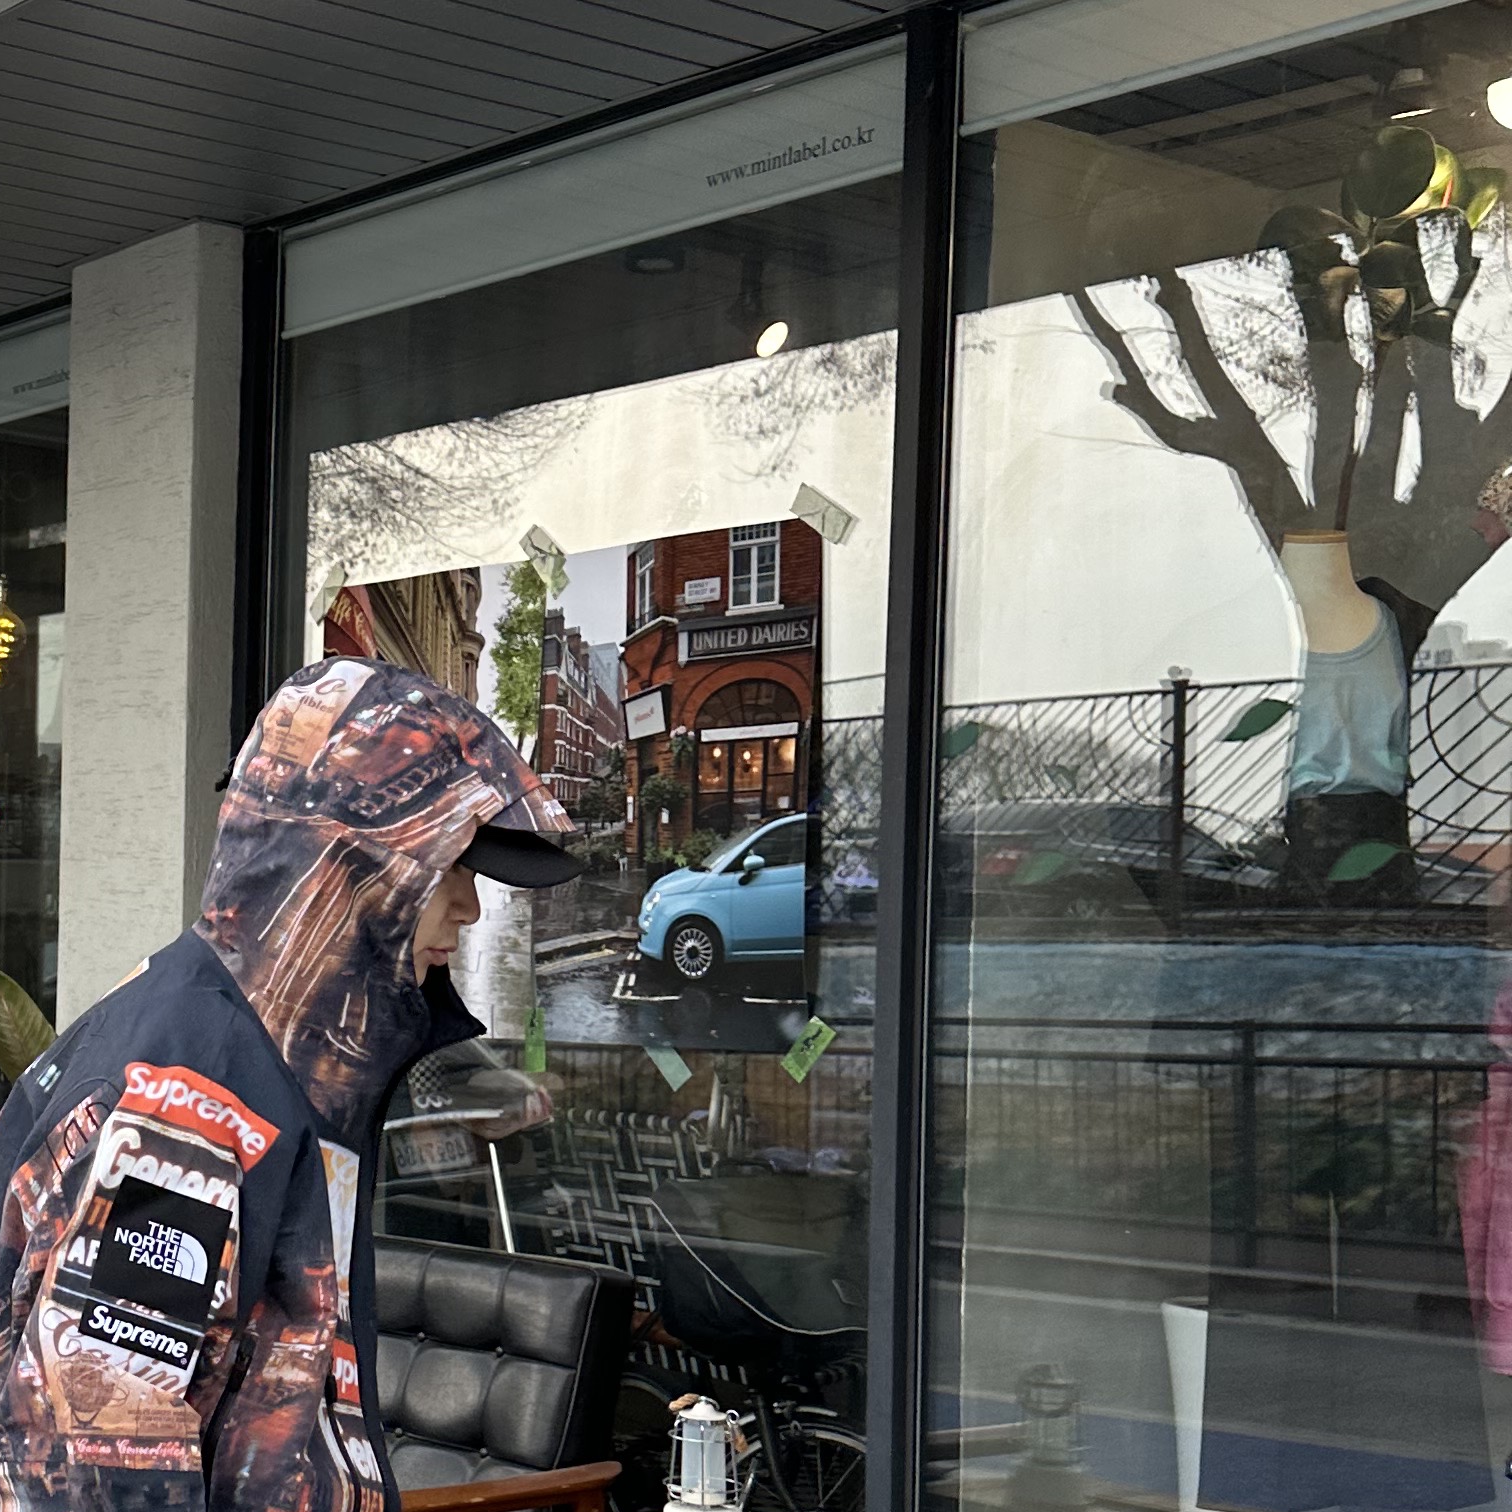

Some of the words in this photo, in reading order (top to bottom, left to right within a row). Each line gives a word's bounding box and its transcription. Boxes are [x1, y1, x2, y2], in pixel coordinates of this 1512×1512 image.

[705, 125, 875, 188] www.mintlabel.co.kr
[693, 627, 748, 651] UNITED
[751, 619, 808, 646] DAIRIES
[125, 1066, 266, 1155] Supreme
[114, 1227, 178, 1259] NORTH
[147, 1220, 182, 1244] THE
[128, 1246, 176, 1275] FACE
[88, 1304, 189, 1359] Supreme
